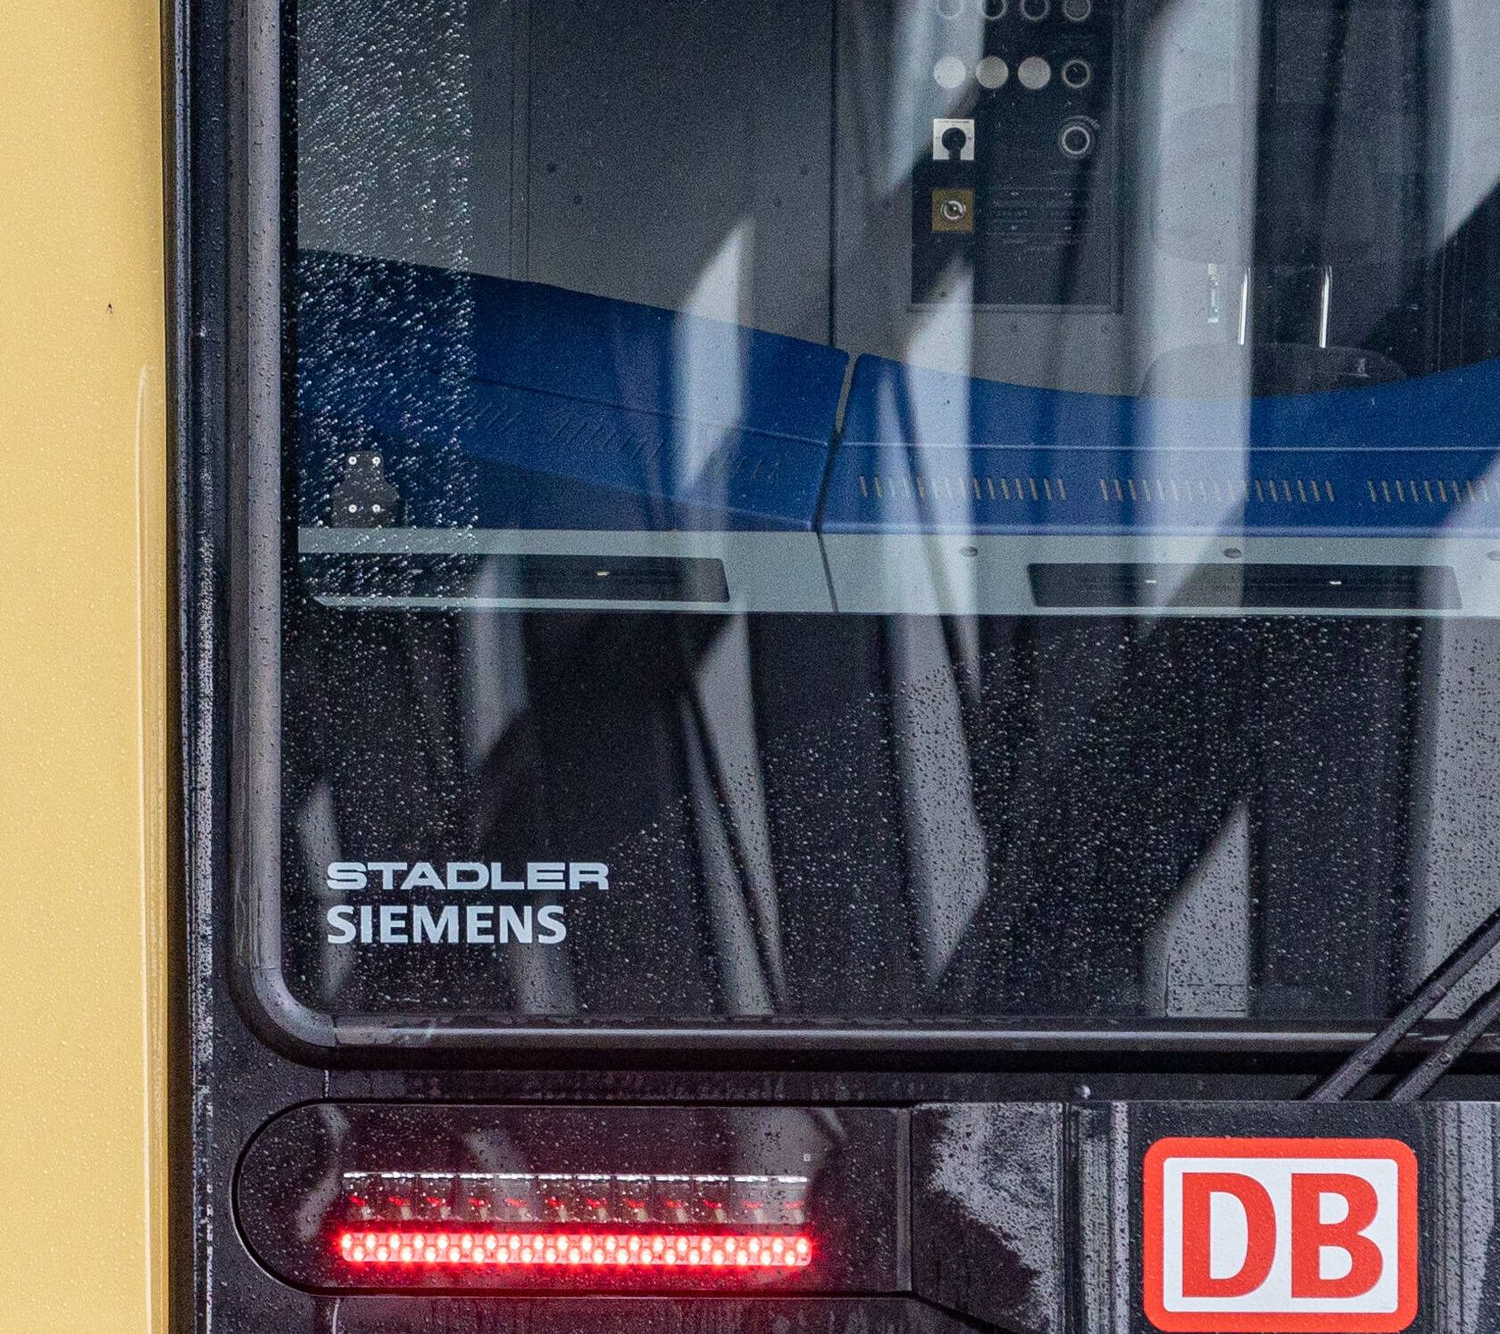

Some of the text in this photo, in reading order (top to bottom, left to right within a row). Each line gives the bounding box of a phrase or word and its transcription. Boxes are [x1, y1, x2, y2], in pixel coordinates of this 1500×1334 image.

[326, 862, 610, 891] STADLER
[326, 905, 567, 944] SIEMENS
[1182, 1171, 1384, 1299] DB
